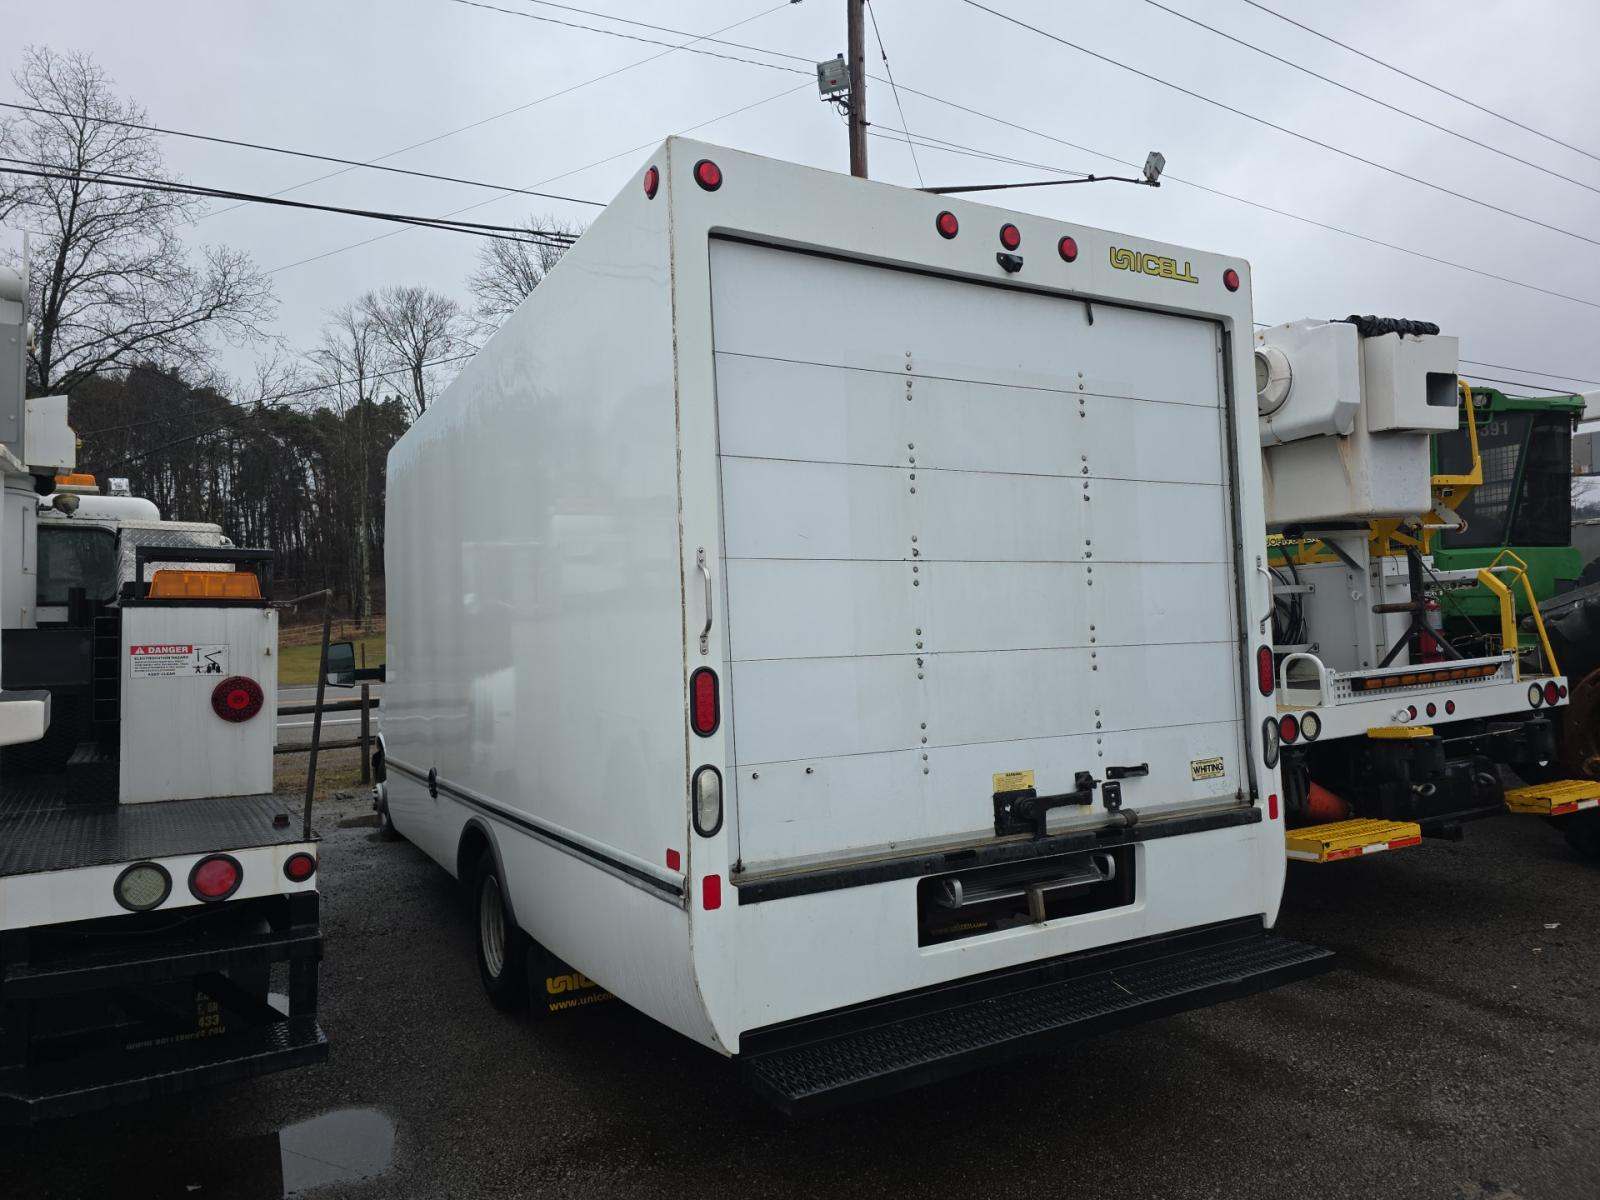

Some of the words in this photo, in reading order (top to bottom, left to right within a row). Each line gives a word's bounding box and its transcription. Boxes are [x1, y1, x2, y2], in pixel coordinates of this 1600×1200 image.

[1110, 246, 1198, 284] UNICELL
[148, 646, 189, 654] DANGER
[1193, 763, 1224, 774] WHITING
